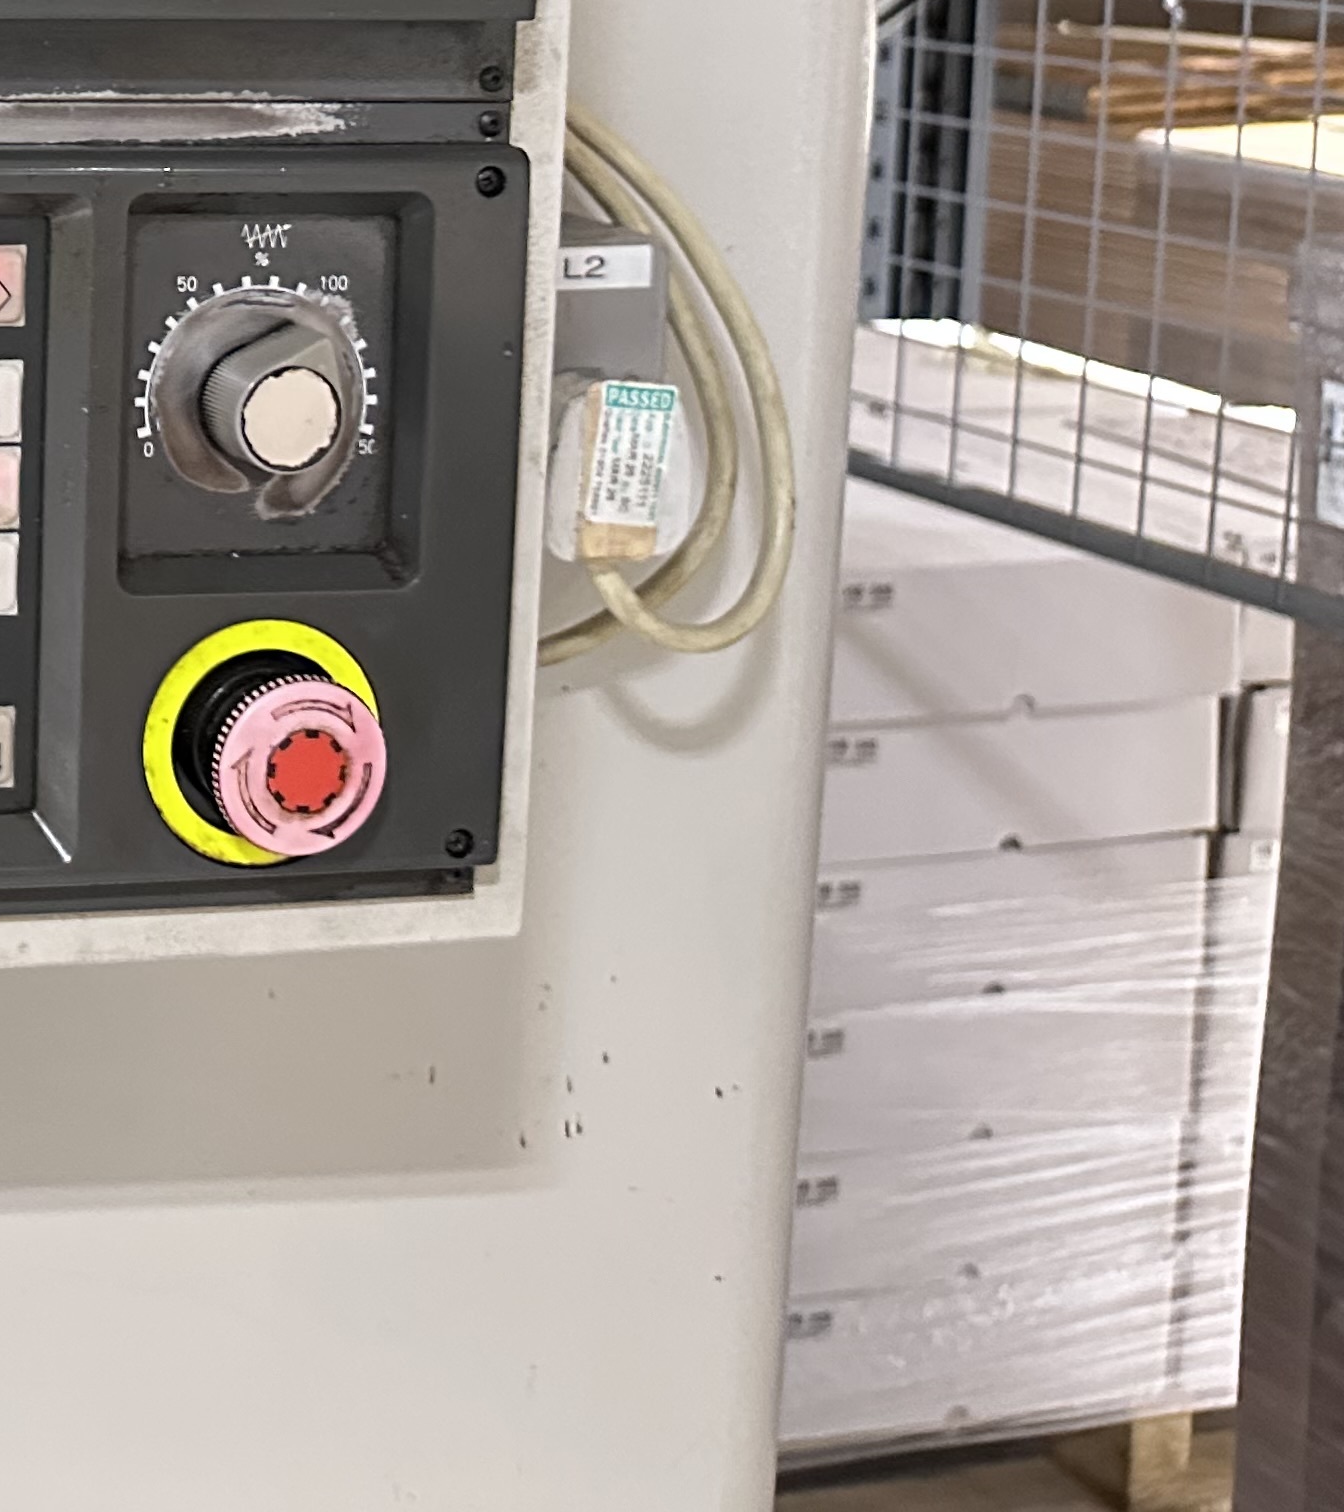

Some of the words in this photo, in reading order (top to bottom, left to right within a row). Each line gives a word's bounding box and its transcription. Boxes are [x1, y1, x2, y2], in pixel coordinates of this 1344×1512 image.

[563, 256, 605, 280] L2
[178, 276, 197, 292] 50
[320, 275, 349, 292] 100
[608, 385, 673, 410] PASSED
[143, 442, 154, 458] 0
